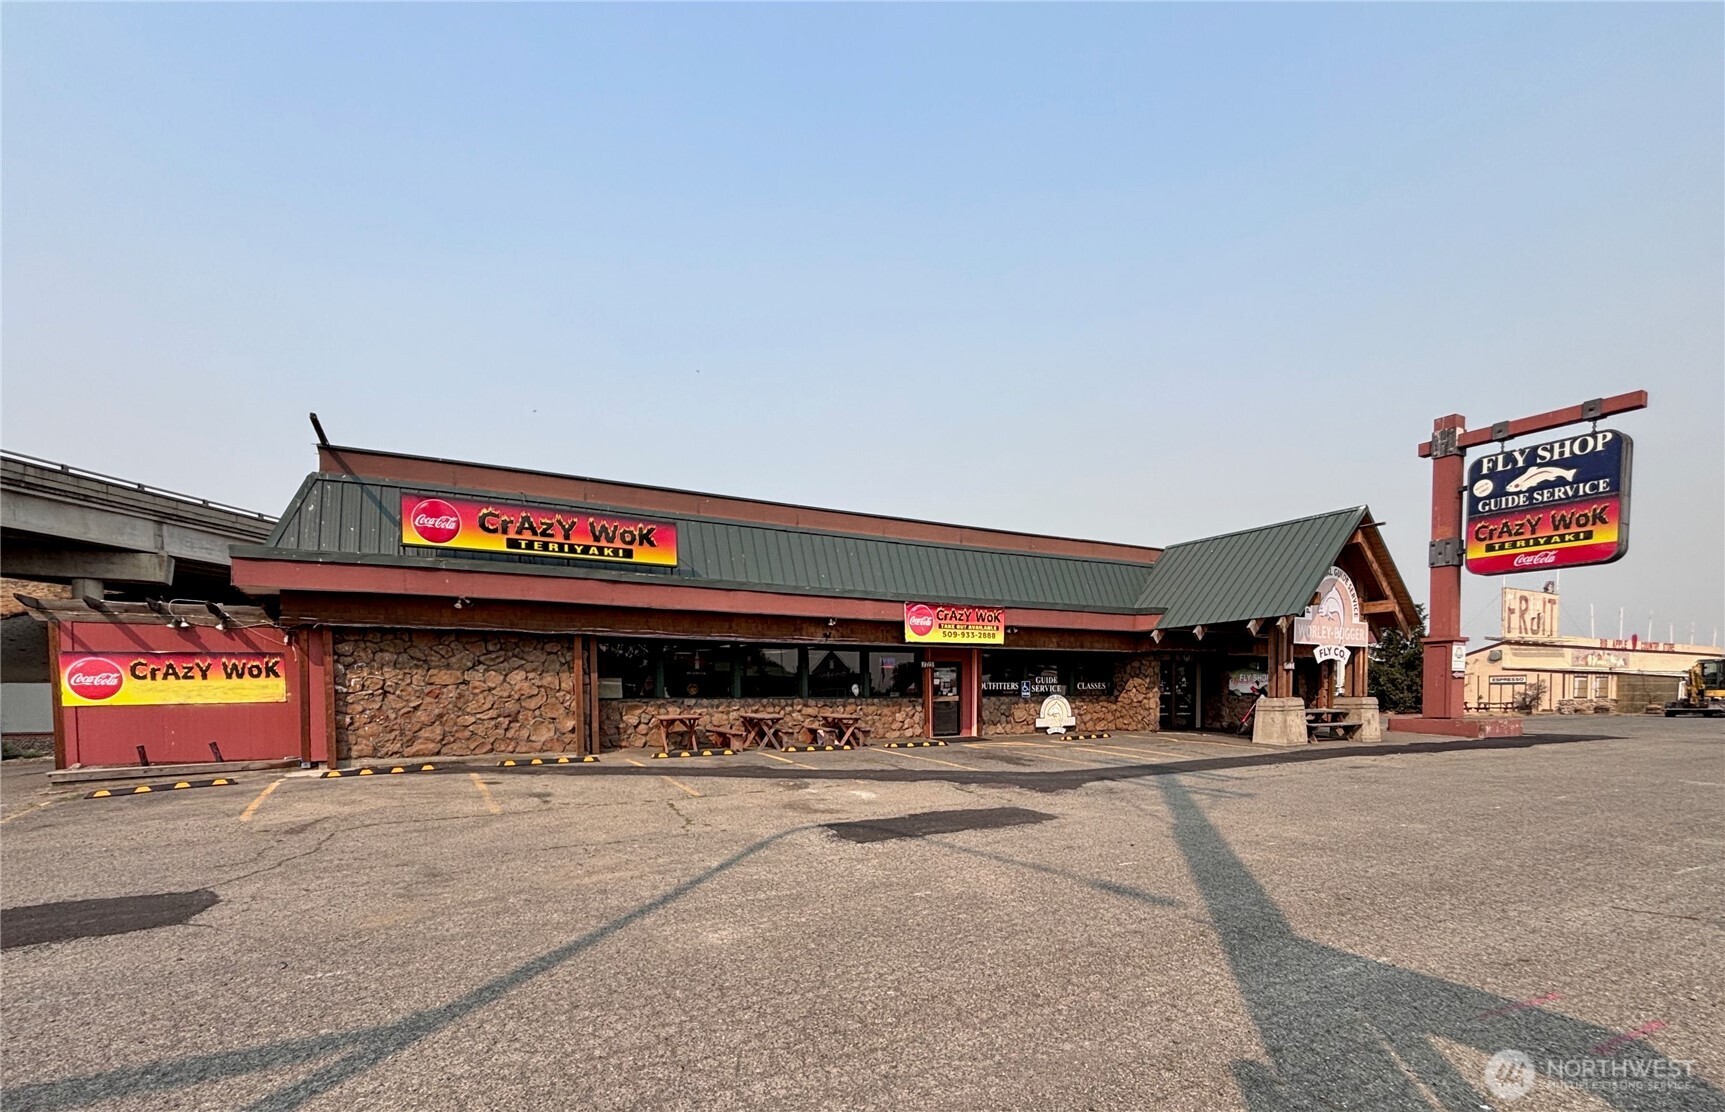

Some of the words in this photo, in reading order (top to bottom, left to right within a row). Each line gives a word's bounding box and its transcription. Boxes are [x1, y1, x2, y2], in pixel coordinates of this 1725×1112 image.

[1480, 448, 1530, 475] FLY
[1536, 431, 1613, 464] SHOP
[1477, 493, 1530, 513] GUIDE
[1533, 478, 1610, 503] SERVICE
[518, 540, 625, 558] TERIYAKI
[1493, 533, 1585, 550] TERIYAKI
[1334, 568, 1349, 585] GUIDE
[1347, 584, 1359, 617] SERVICE
[942, 630, 996, 639] 509-933-2888
[1298, 623, 1365, 640] WORLEY-BUGGER
[1319, 647, 1332, 658] FLY
[1333, 647, 1346, 660] CO.
[1031, 684, 1062, 693] SERVICE
[1035, 676, 1058, 684] GUIDE
[1076, 682, 1106, 690] CLASSES
